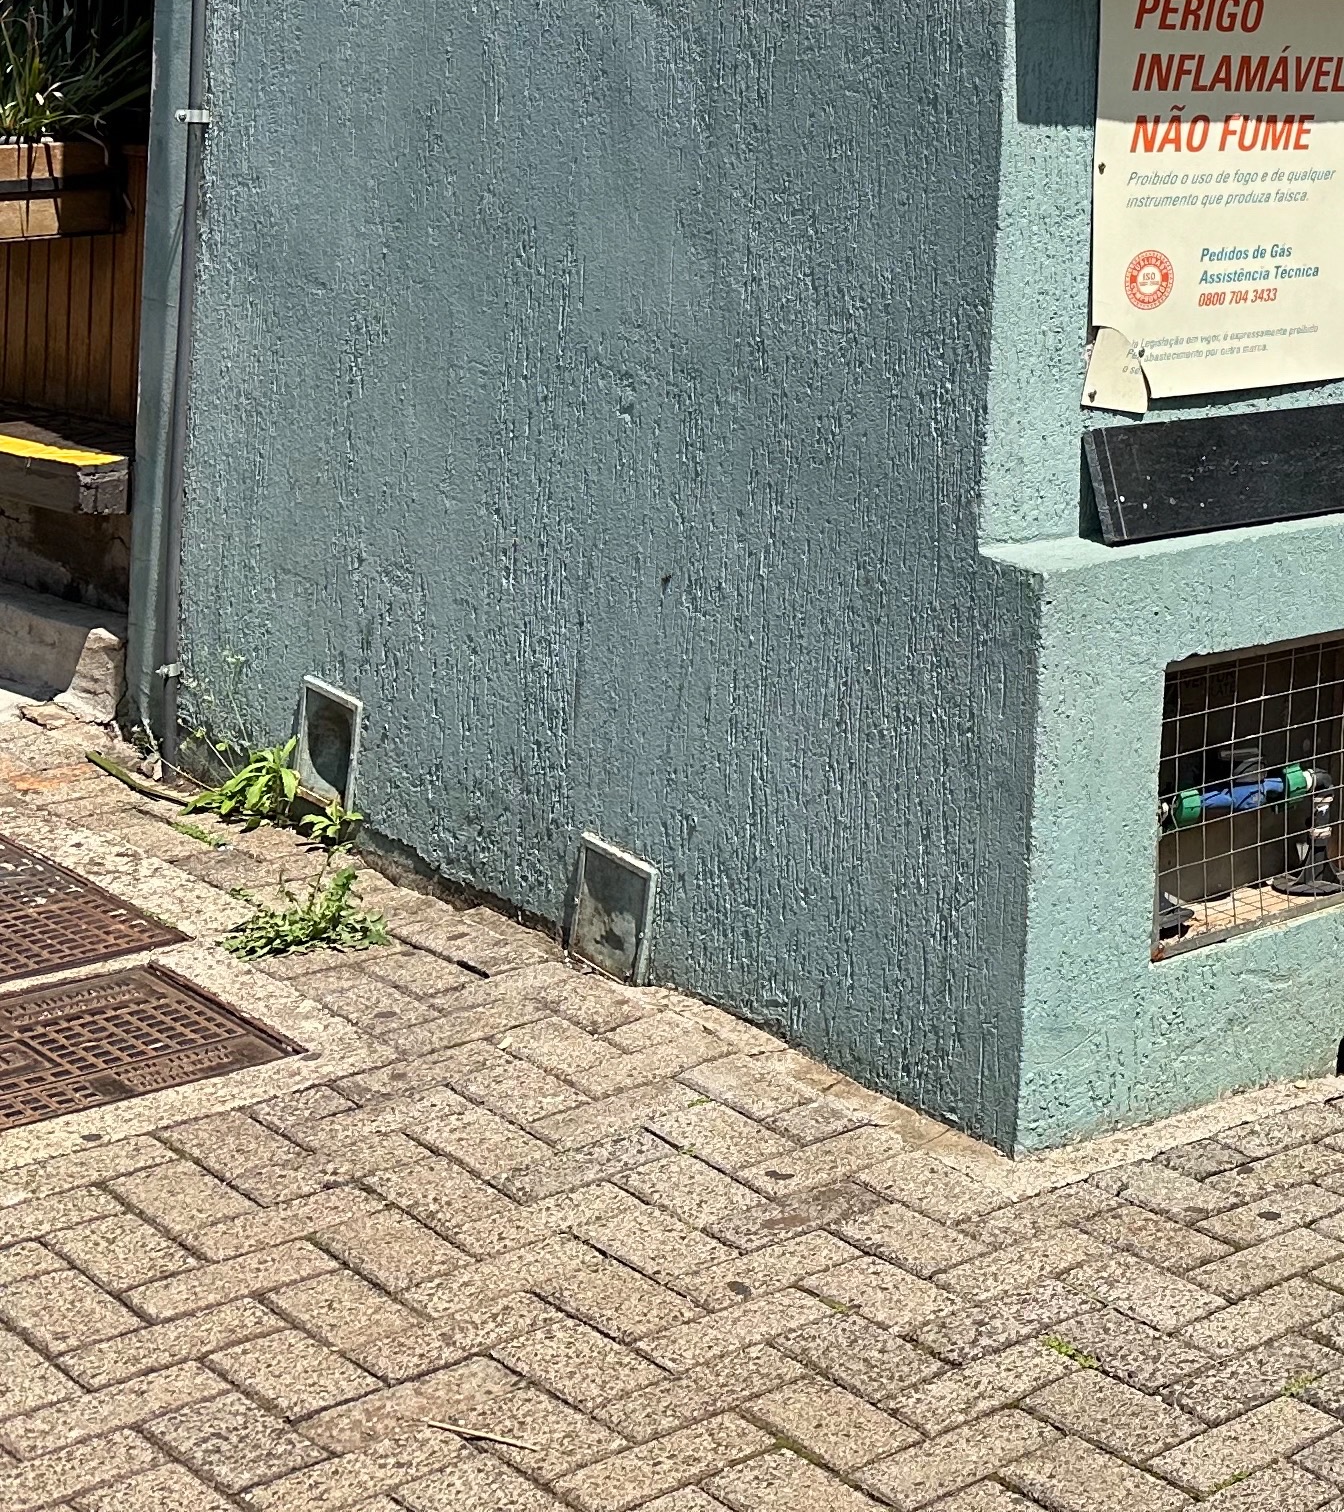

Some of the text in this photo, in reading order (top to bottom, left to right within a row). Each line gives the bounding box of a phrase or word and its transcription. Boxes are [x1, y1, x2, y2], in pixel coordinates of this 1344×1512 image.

[1129, 103, 1314, 154] NÃO FUME
[1126, 166, 1337, 187] Proibido o uso de fogo e de qualquer
[1126, 192, 1199, 209] instrumento
[1200, 192, 1224, 208] que
[1224, 189, 1272, 207] produza
[1200, 245, 1249, 262] Pedidos
[1252, 244, 1266, 259] de
[1198, 262, 1320, 285] Assistência Técnica
[1198, 288, 1278, 307] 0800 704 3433
